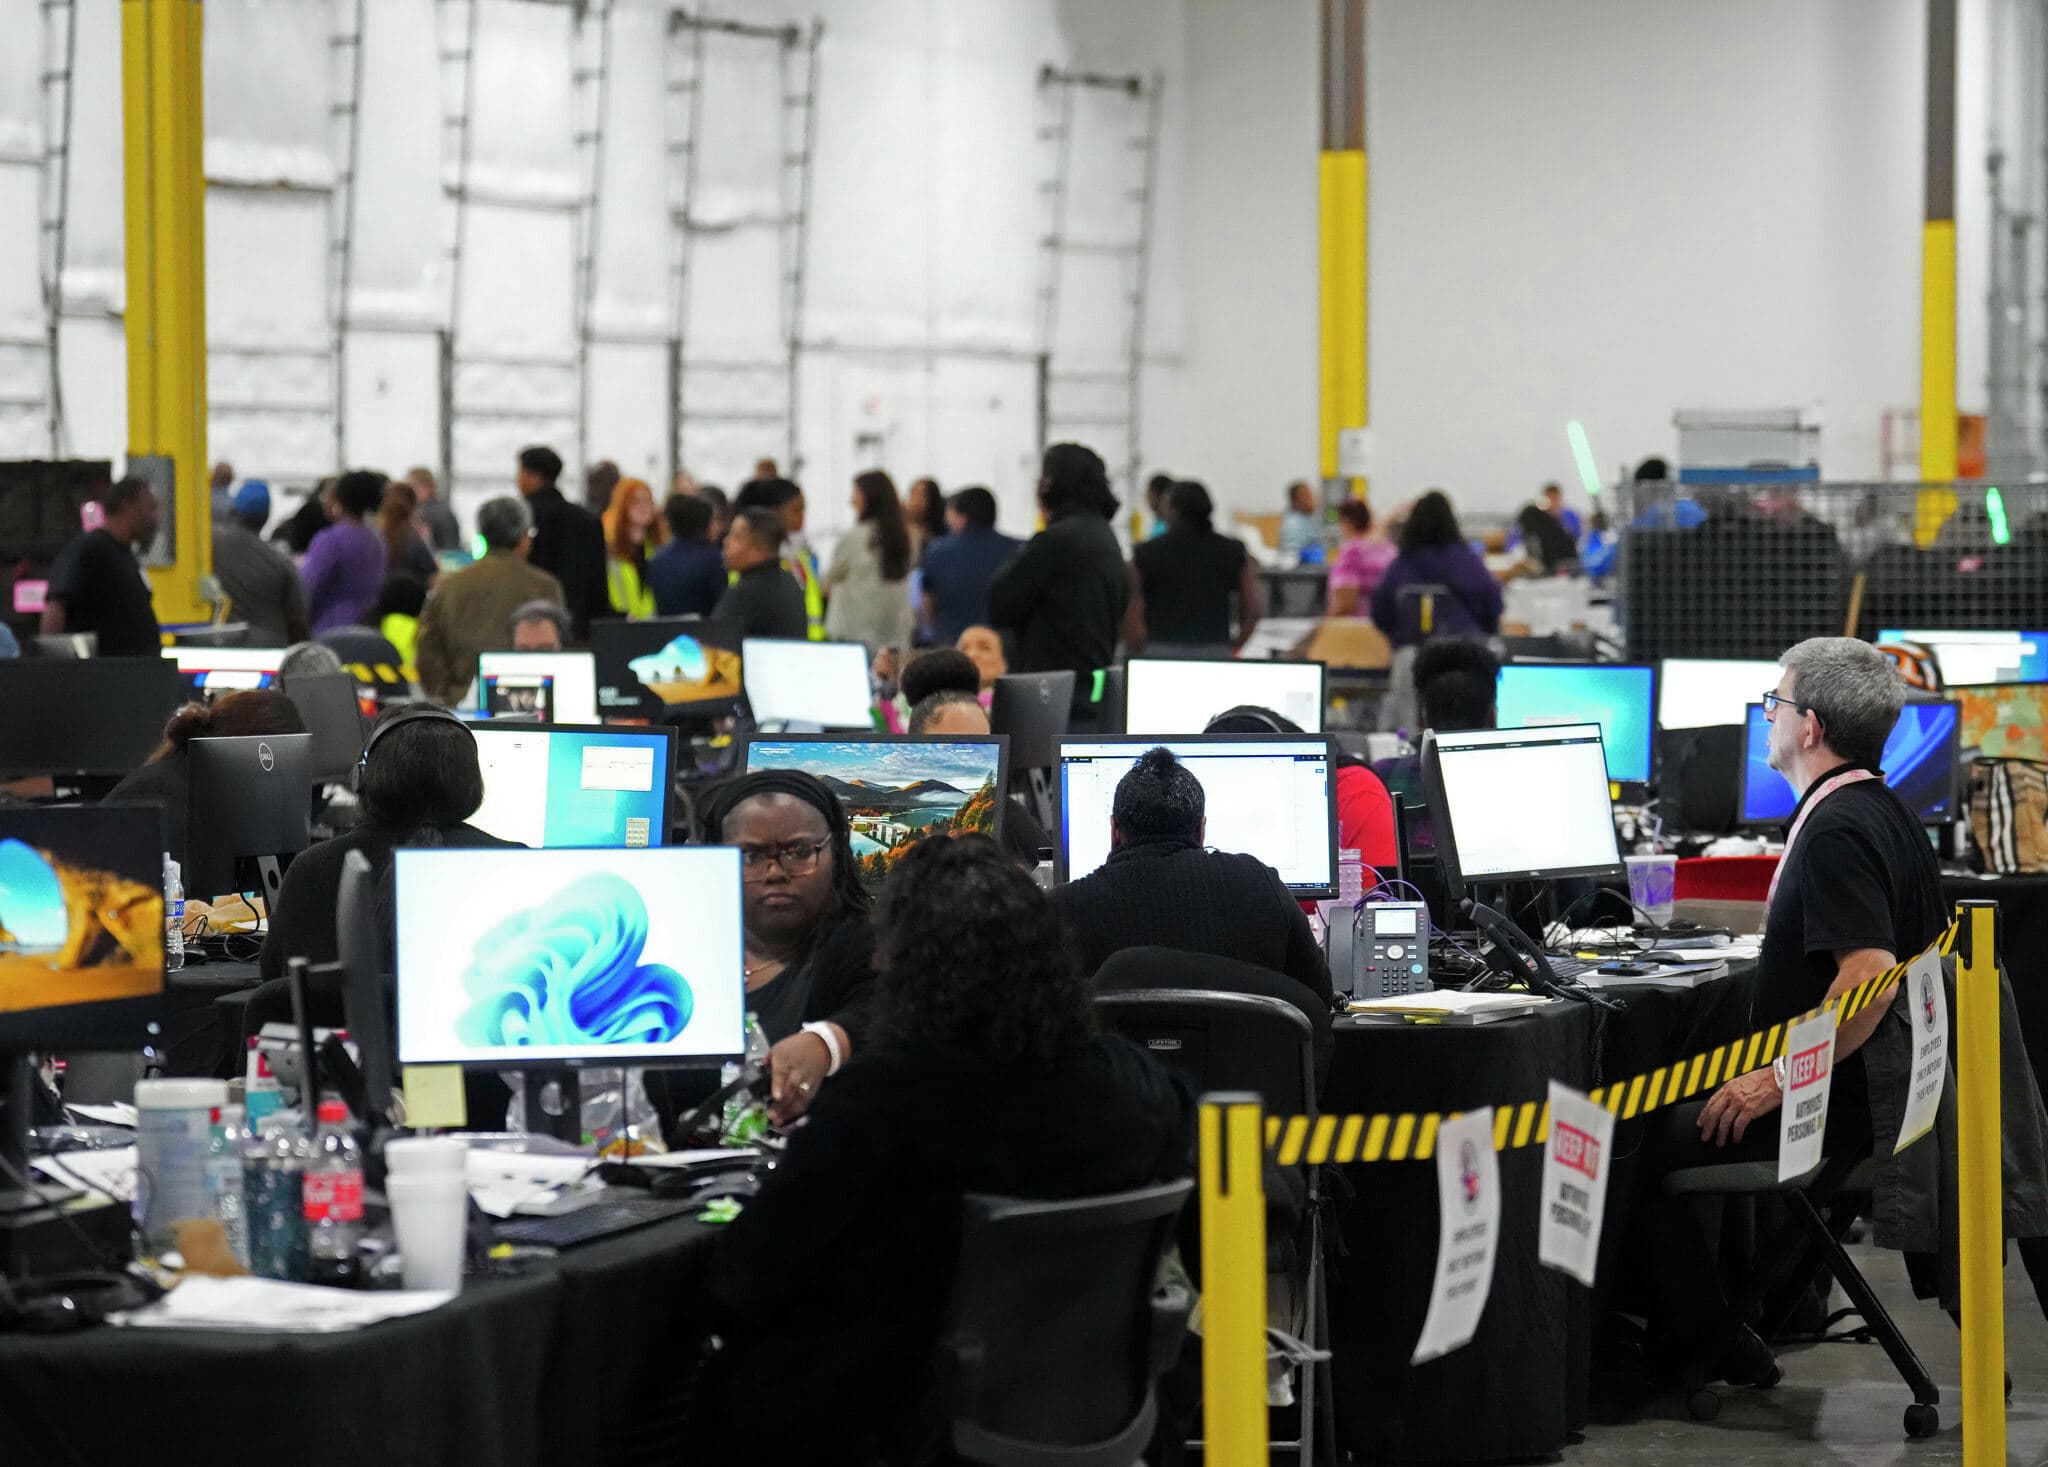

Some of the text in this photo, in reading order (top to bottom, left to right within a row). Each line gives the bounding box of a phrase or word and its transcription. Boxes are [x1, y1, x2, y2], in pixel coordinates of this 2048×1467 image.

[1920, 1035, 1942, 1060] EMPLOYEES
[1792, 1053, 1815, 1086] KEEP
[1926, 1056, 1943, 1078] BEYOND
[1787, 1116, 1816, 1144] PERSONNEL
